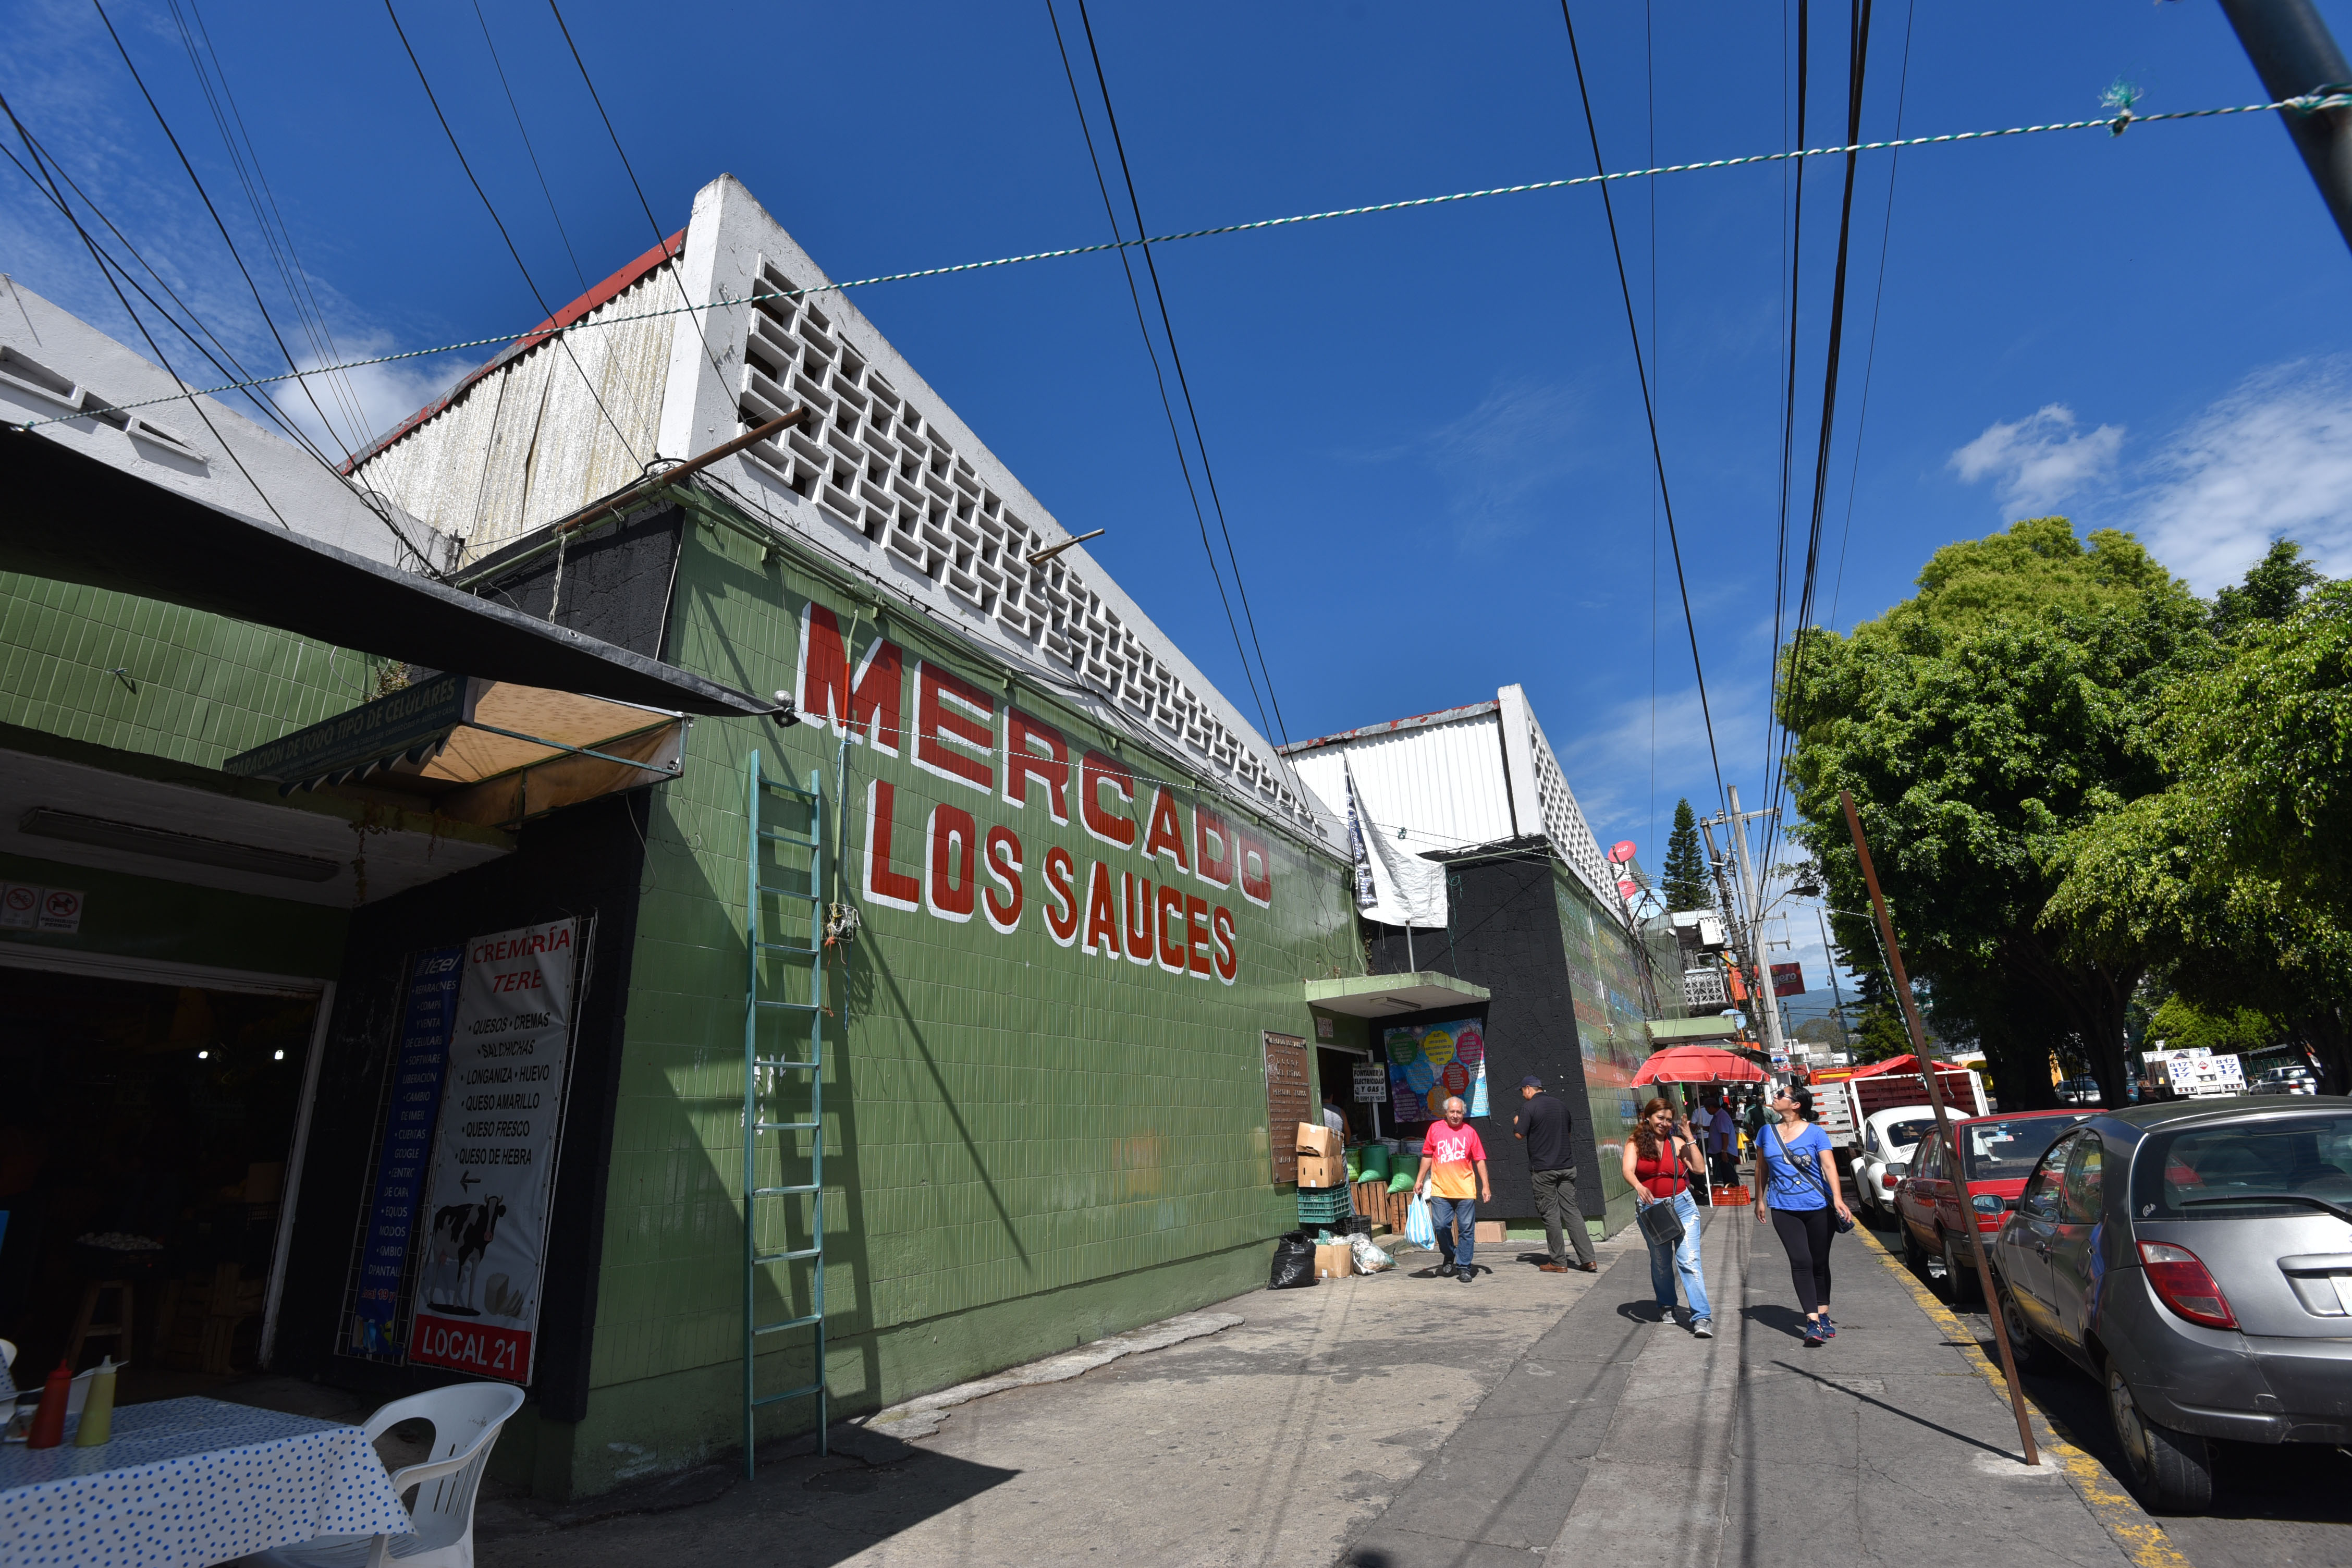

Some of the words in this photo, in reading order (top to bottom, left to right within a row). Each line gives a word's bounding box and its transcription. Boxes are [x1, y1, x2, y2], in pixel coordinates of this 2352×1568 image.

[286, 738, 301, 757] DE
[337, 713, 364, 741] TIPO
[366, 705, 384, 730] DE
[385, 678, 455, 724] CELULARES
[797, 601, 1272, 909] MERCADO
[863, 778, 1024, 934] LOS
[1043, 846, 1237, 986] SAUCES
[493, 969, 542, 993] TERE
[473, 1017, 508, 1035] QUESOS
[514, 1012, 550, 1031] CREMAS
[405, 1038, 413, 1048] DE
[482, 1039, 535, 1058] SALCHICHAS
[408, 1054, 440, 1066] SOFTWARE
[402, 1069, 438, 1084] LIBERACIÓN
[467, 1067, 512, 1085] LONGANIZA
[519, 1064, 549, 1082] HUEVO
[406, 1091, 431, 1102] CAMBIO
[466, 1094, 495, 1112] QUESO
[496, 1093, 540, 1110] AMARILLO
[398, 1129, 426, 1140] CUENTAS
[467, 1121, 495, 1137] QUESO
[496, 1121, 530, 1137] FRESCO
[1437, 1136, 1466, 1156] RUN
[459, 1148, 487, 1165] QUESO
[489, 1148, 500, 1165] DE
[501, 1148, 531, 1165] HEBRA
[1440, 1149, 1466, 1164] RACE
[384, 1187, 393, 1197] DE
[377, 1289, 388, 1301] 19
[422, 1326, 487, 1365] LOCAL
[493, 1339, 517, 1371] 21
